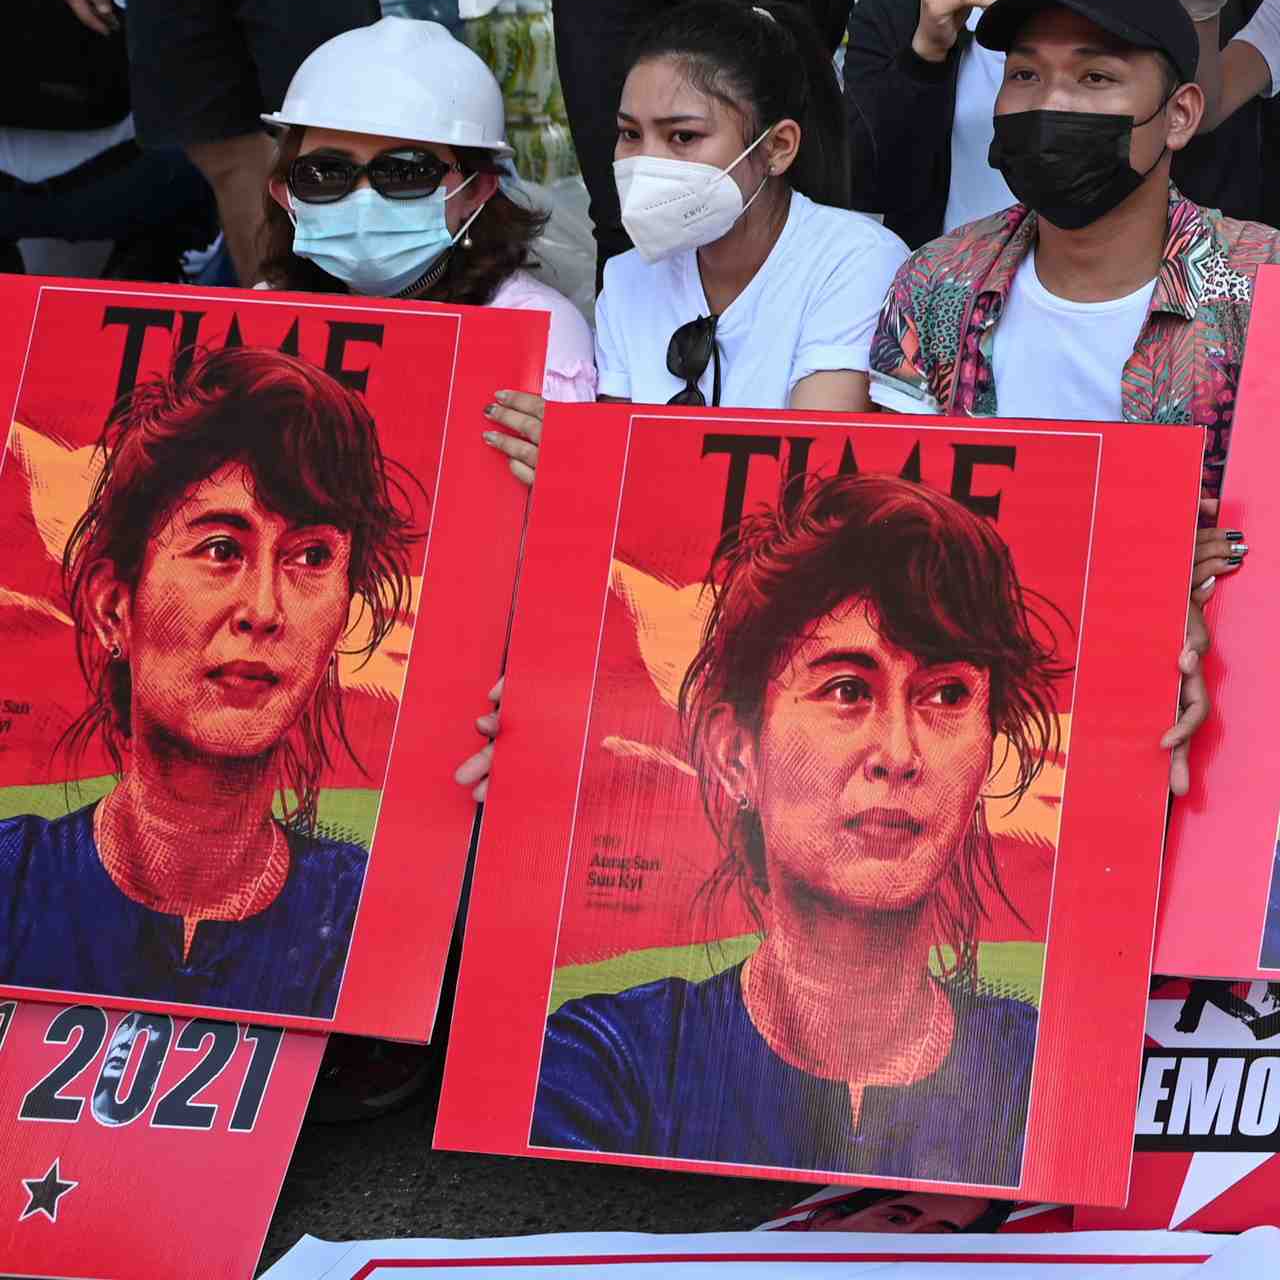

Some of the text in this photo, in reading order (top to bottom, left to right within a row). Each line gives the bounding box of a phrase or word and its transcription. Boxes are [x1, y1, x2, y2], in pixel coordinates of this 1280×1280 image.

[102, 306, 384, 420] TIE
[699, 433, 1016, 543] TIE
[17, 1004, 286, 1133] 2021
